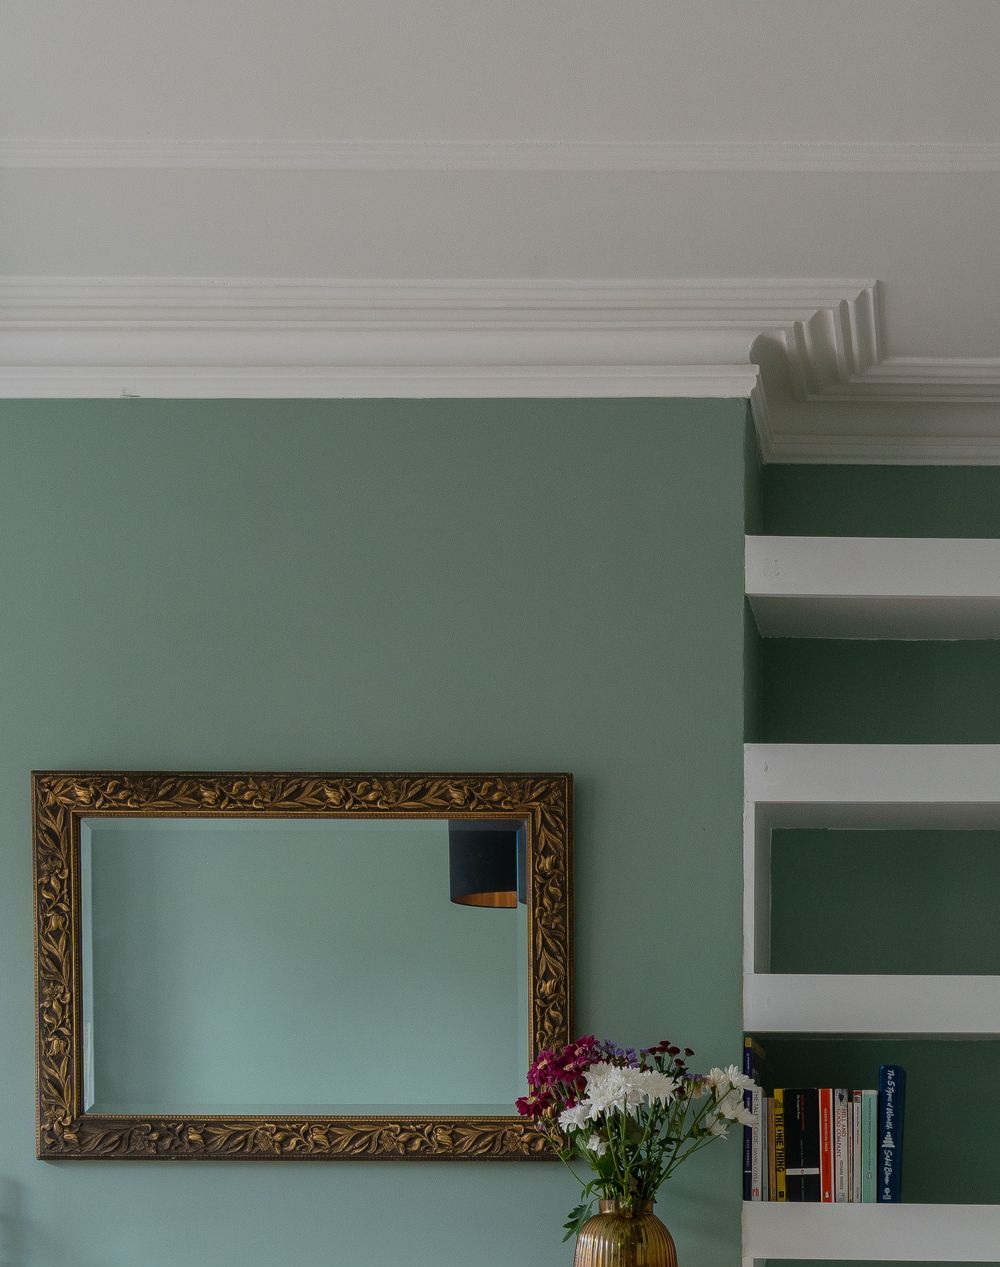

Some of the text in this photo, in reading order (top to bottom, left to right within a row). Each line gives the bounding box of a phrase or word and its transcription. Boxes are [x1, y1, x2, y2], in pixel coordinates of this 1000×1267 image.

[887, 1069, 895, 1080] The
[885, 1086, 895, 1102] Types
[885, 1107, 895, 1130] Wealth
[777, 1148, 785, 1173] THING
